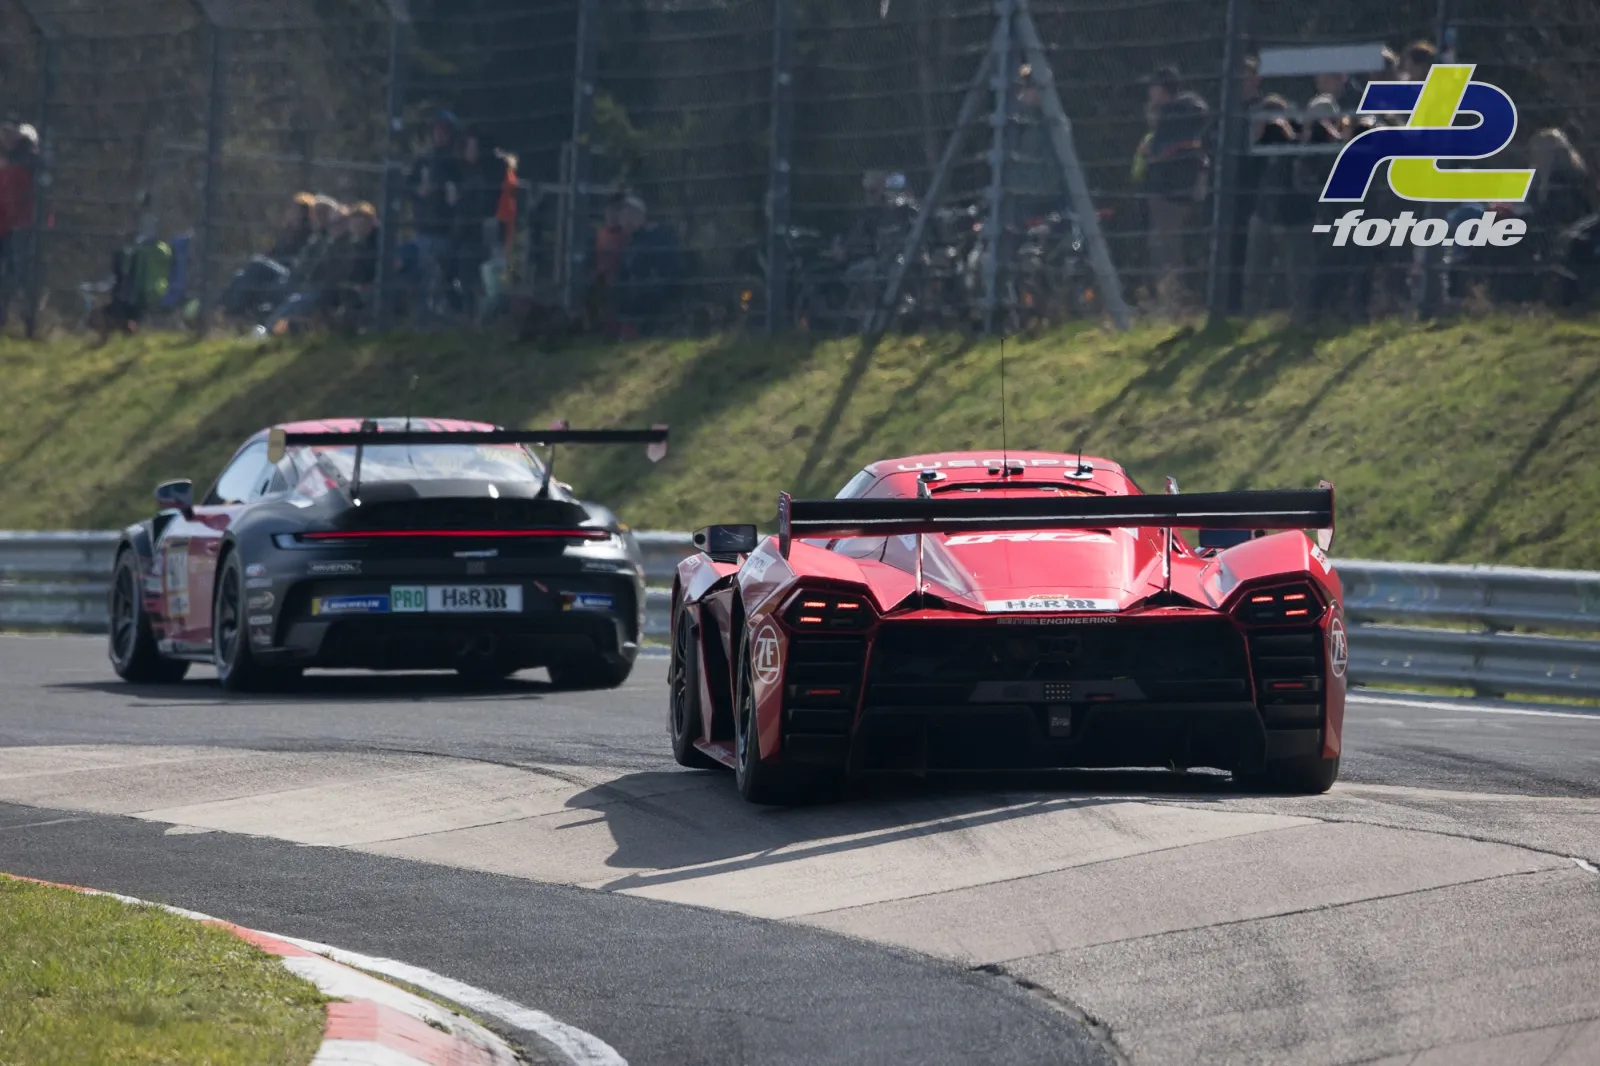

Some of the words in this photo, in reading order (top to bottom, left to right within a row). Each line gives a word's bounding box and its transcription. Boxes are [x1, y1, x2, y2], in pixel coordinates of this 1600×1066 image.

[394, 590, 423, 608] PRO
[1039, 616, 1117, 625] ENGINEERING
[757, 637, 779, 672] ZF
